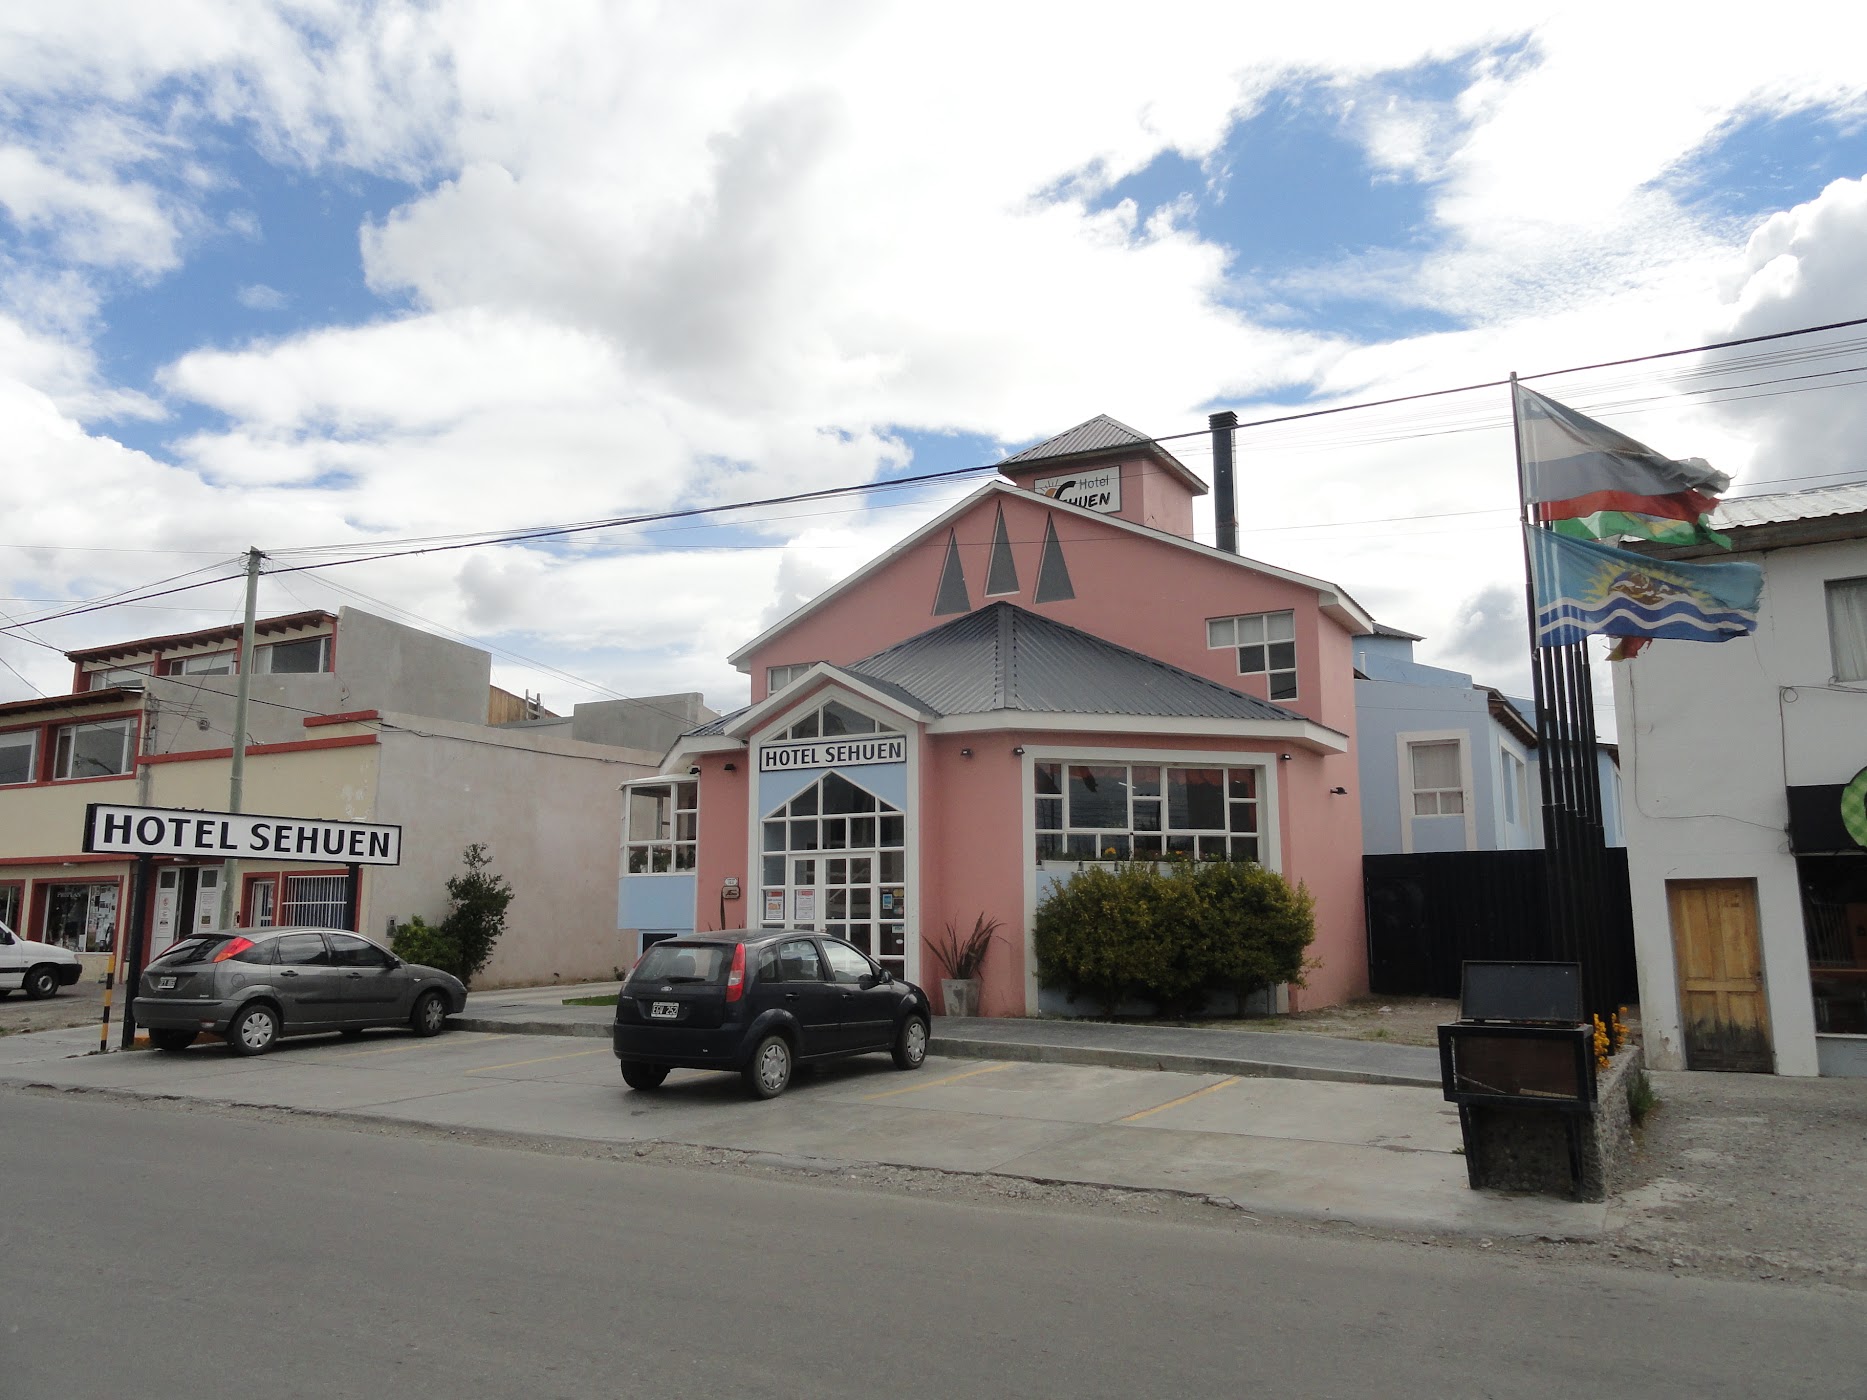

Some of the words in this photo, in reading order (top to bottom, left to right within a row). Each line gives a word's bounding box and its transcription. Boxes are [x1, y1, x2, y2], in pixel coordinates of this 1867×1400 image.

[1080, 474, 1109, 490] Hotel
[765, 748, 820, 767] HOTEL
[825, 742, 901, 763] SEHUEN
[103, 813, 238, 850] HOTEL
[250, 823, 390, 858] SEHUEN
